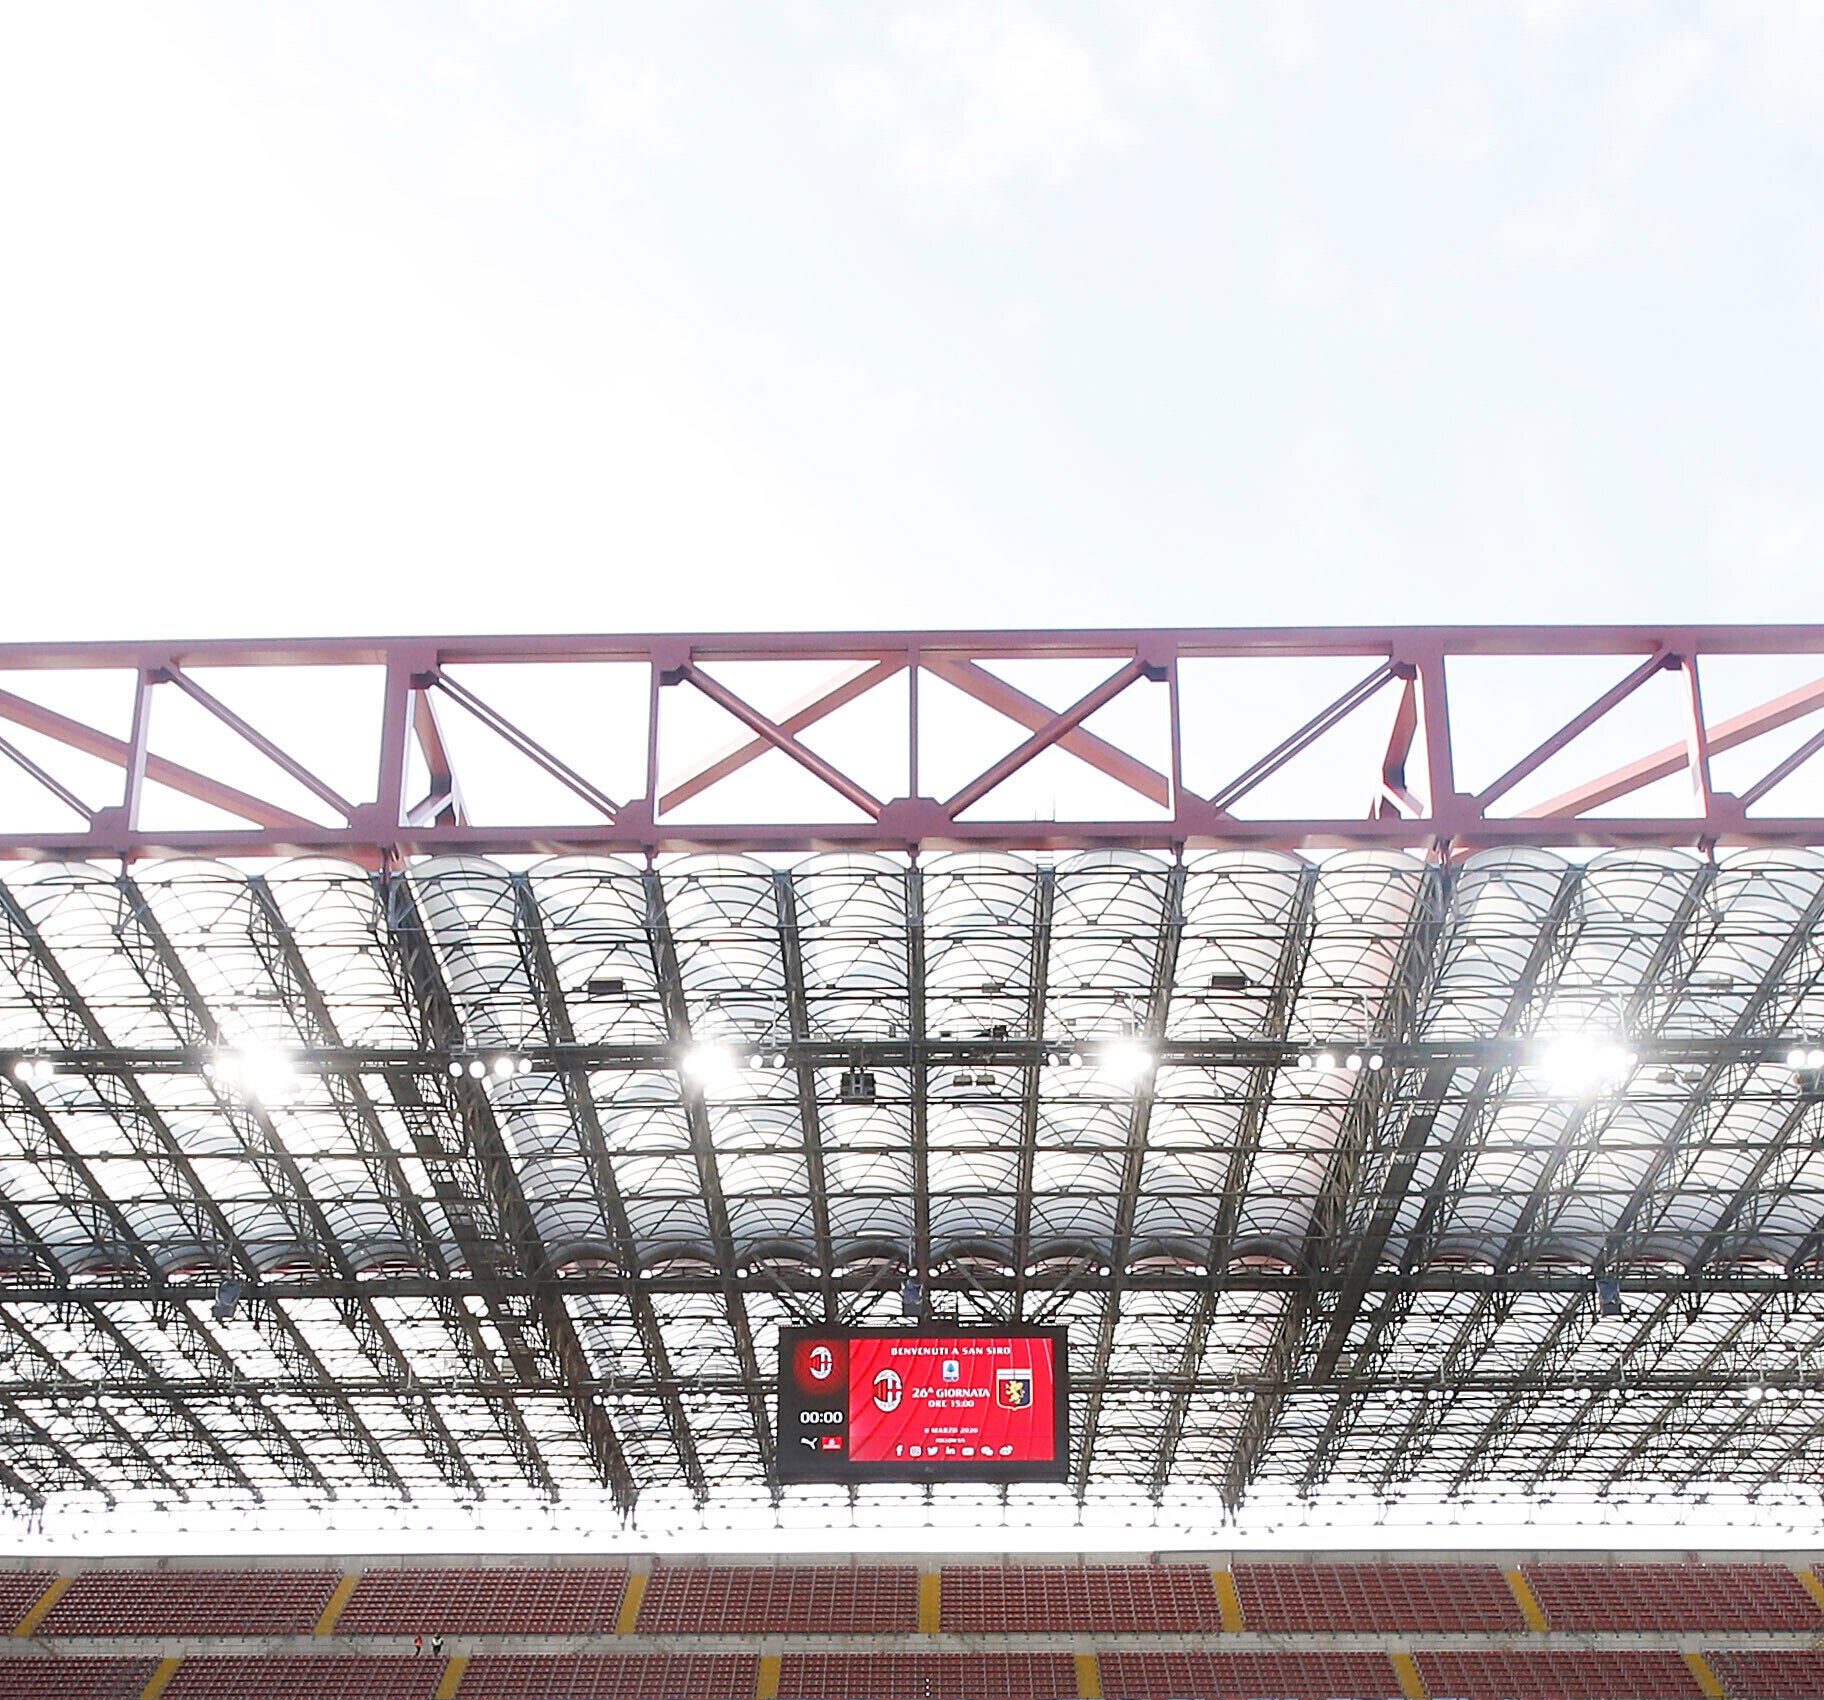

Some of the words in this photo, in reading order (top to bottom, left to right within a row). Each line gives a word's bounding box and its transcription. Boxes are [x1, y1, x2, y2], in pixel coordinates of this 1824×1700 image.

[890, 1347, 949, 1356] BENVENUTI
[951, 1347, 960, 1355] A
[962, 1347, 983, 1355] SAN
[986, 1347, 1012, 1355] SIRO
[936, 1388, 991, 1398] GIORNATA
[928, 1400, 947, 1408] ORE
[800, 1411, 843, 1424] 00:00
